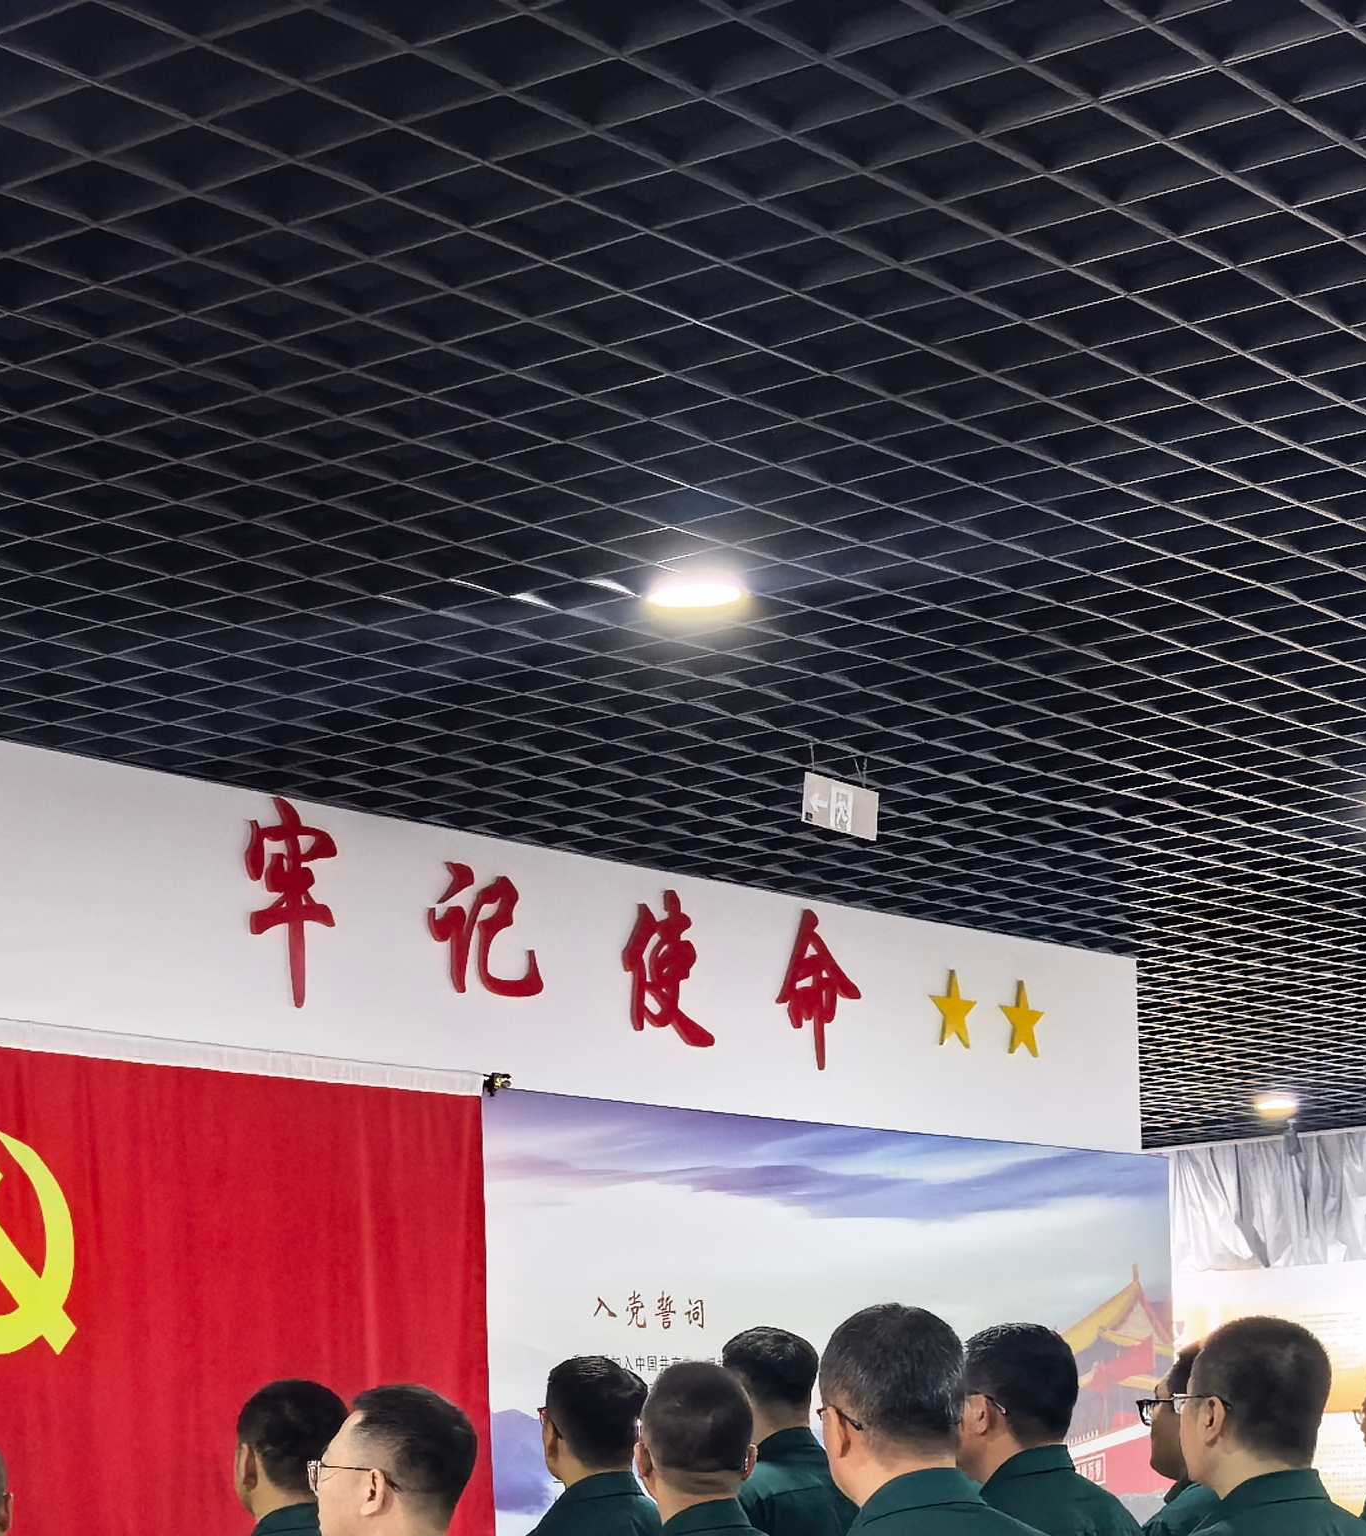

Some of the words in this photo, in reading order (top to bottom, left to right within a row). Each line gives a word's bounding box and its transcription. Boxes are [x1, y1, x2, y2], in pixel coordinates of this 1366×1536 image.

[244, 796, 863, 1071] 牢记使命
[593, 1290, 706, 1329] 入党誓词
